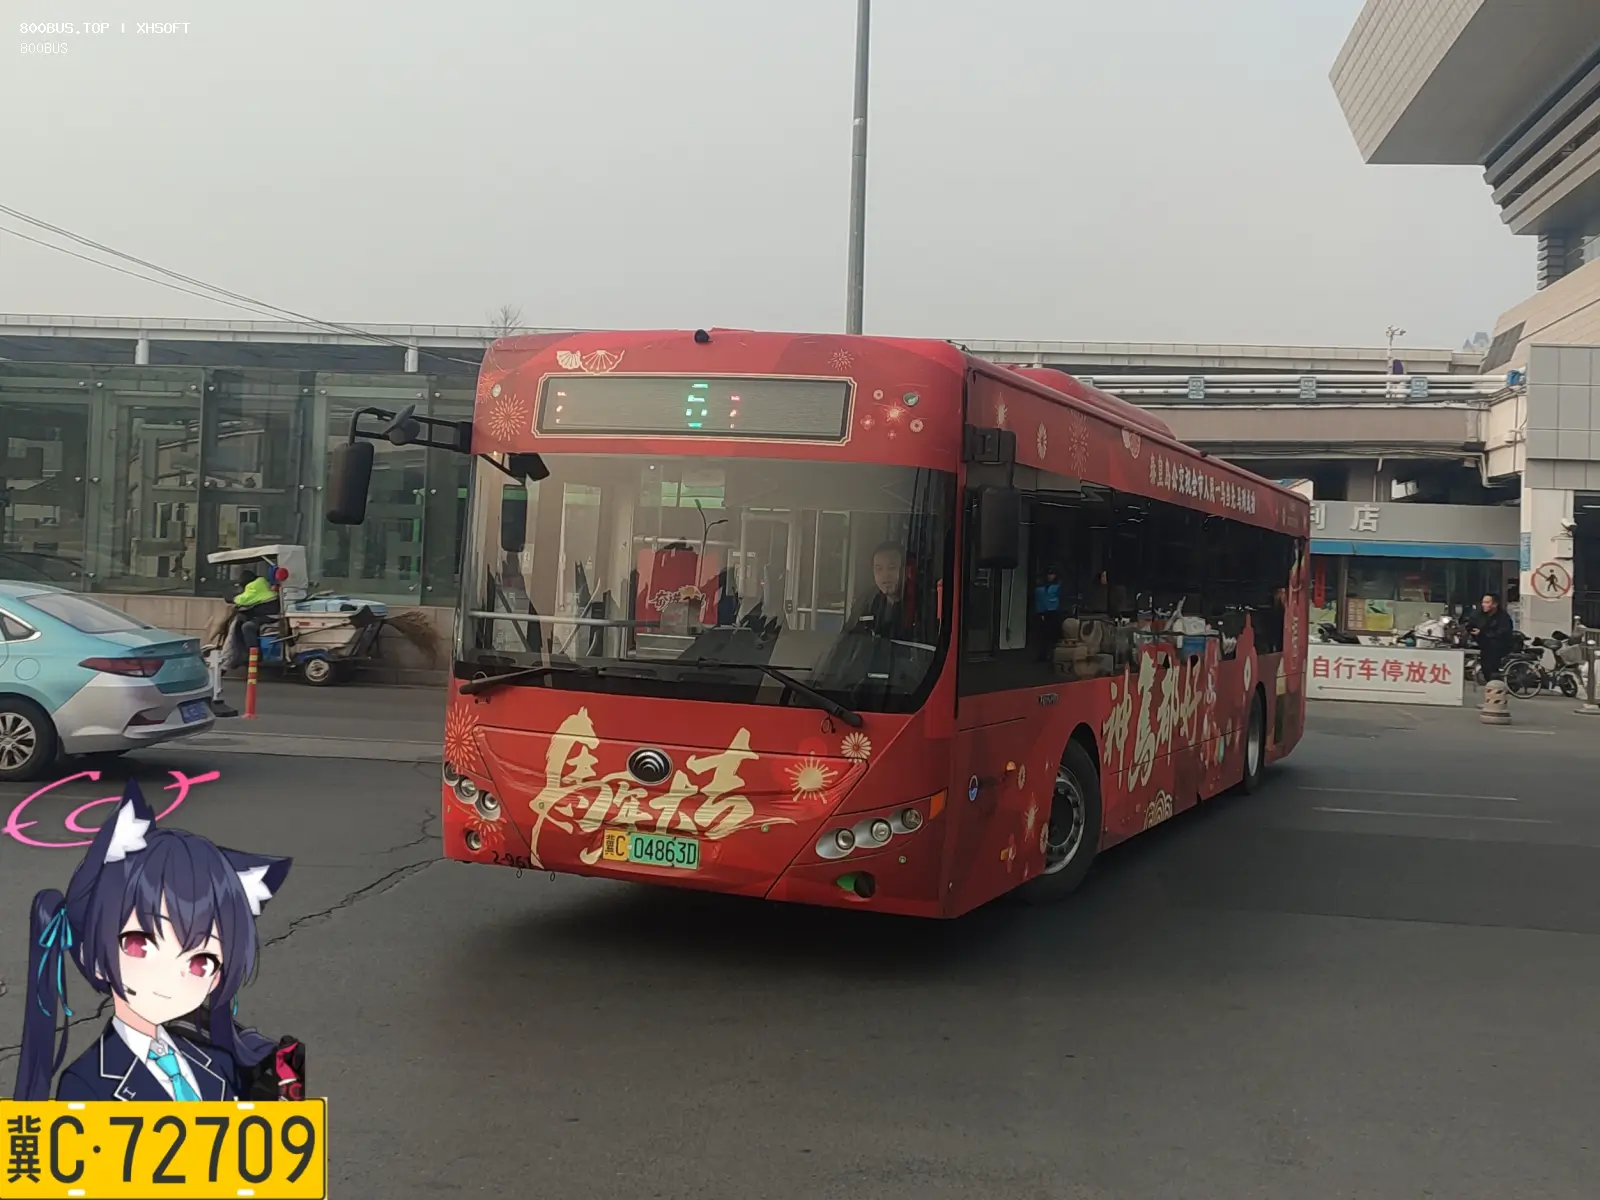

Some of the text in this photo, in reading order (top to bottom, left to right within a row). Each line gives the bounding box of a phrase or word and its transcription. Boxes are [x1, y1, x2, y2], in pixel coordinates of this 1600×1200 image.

[1312, 655, 1452, 685] 自行车停放处
